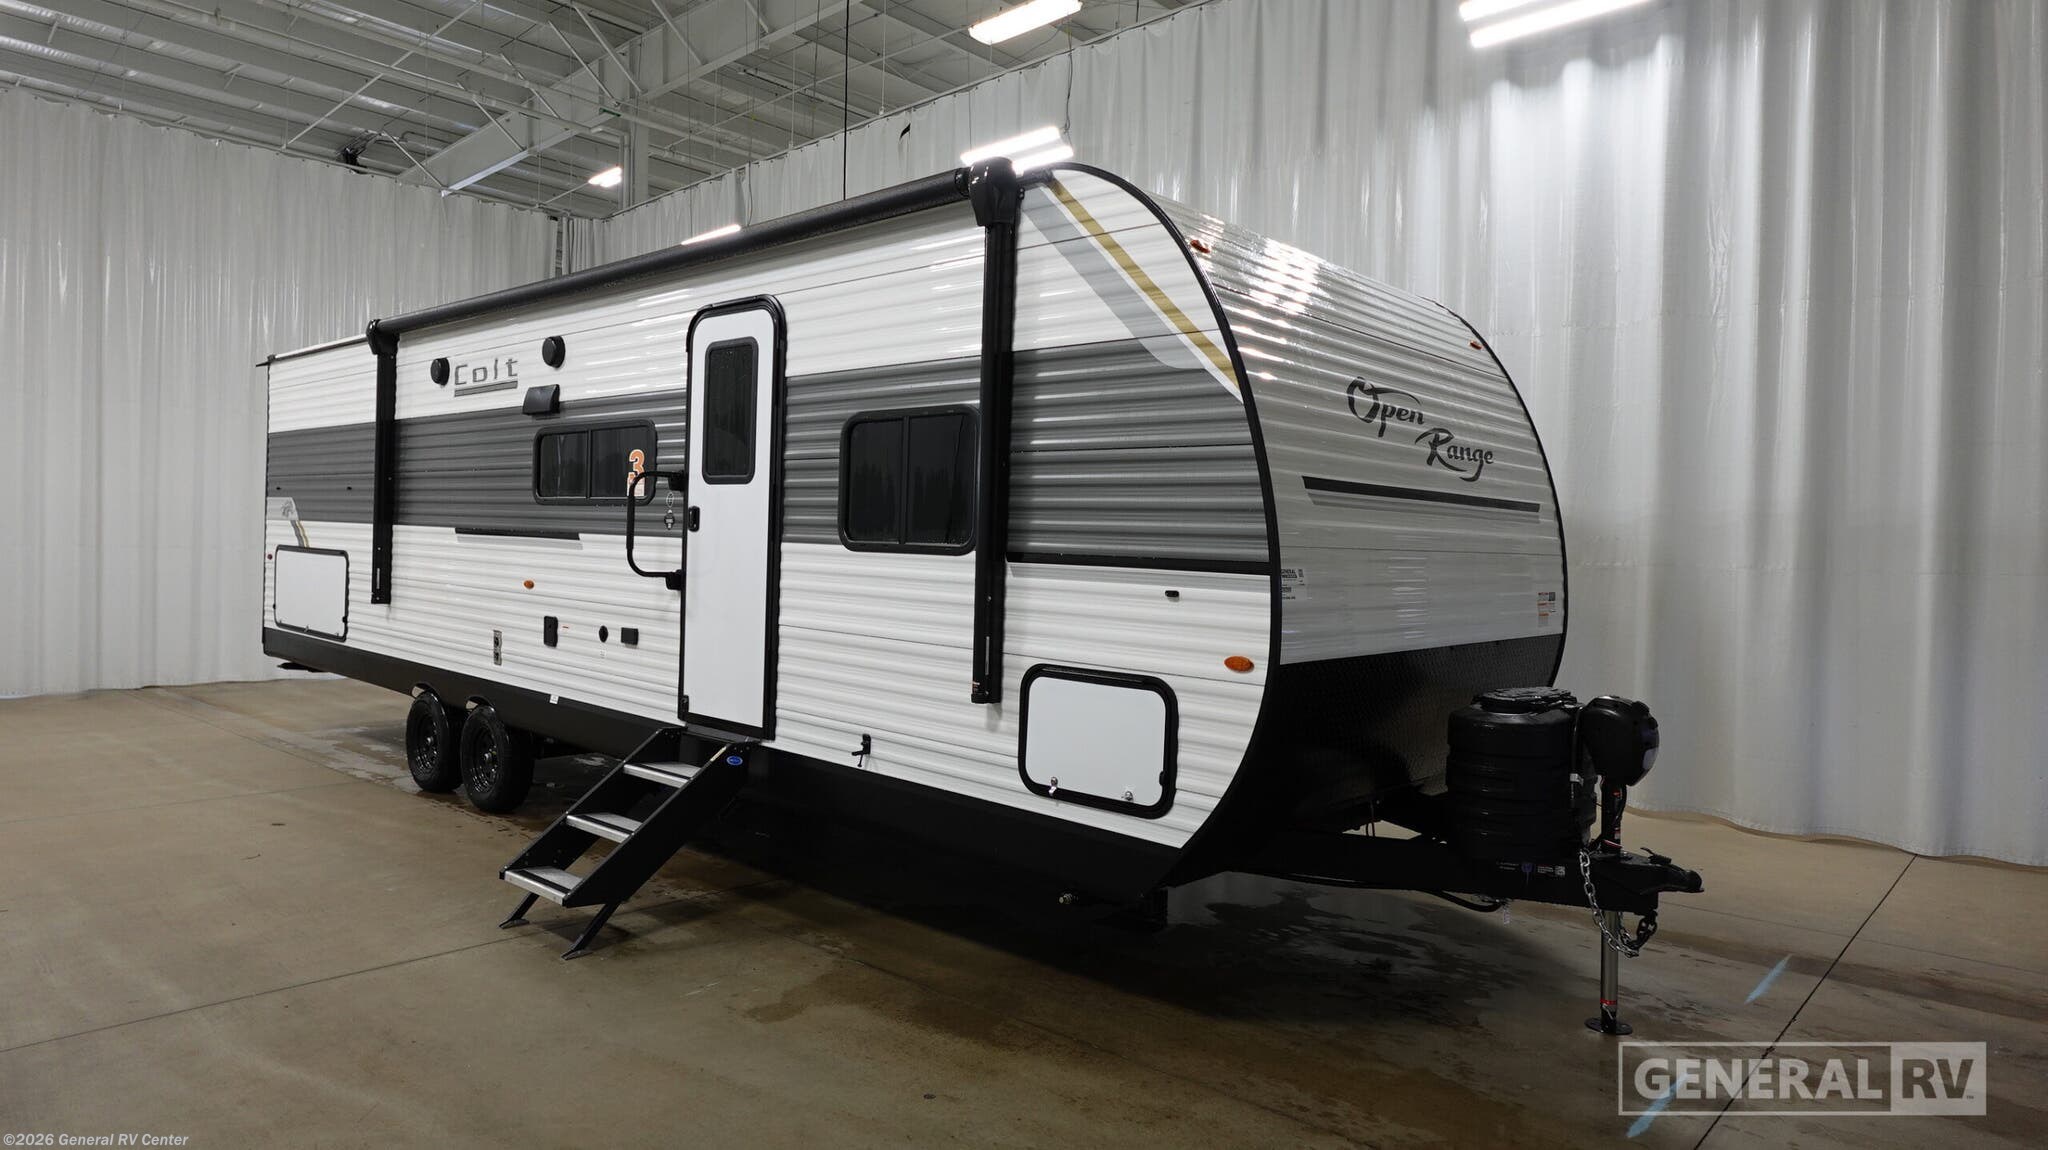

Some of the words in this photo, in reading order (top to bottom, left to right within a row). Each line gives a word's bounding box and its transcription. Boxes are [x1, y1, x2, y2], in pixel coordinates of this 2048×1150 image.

[454, 358, 518, 385] Colt
[1346, 376, 1425, 438] Open
[1415, 427, 1494, 482] Range
